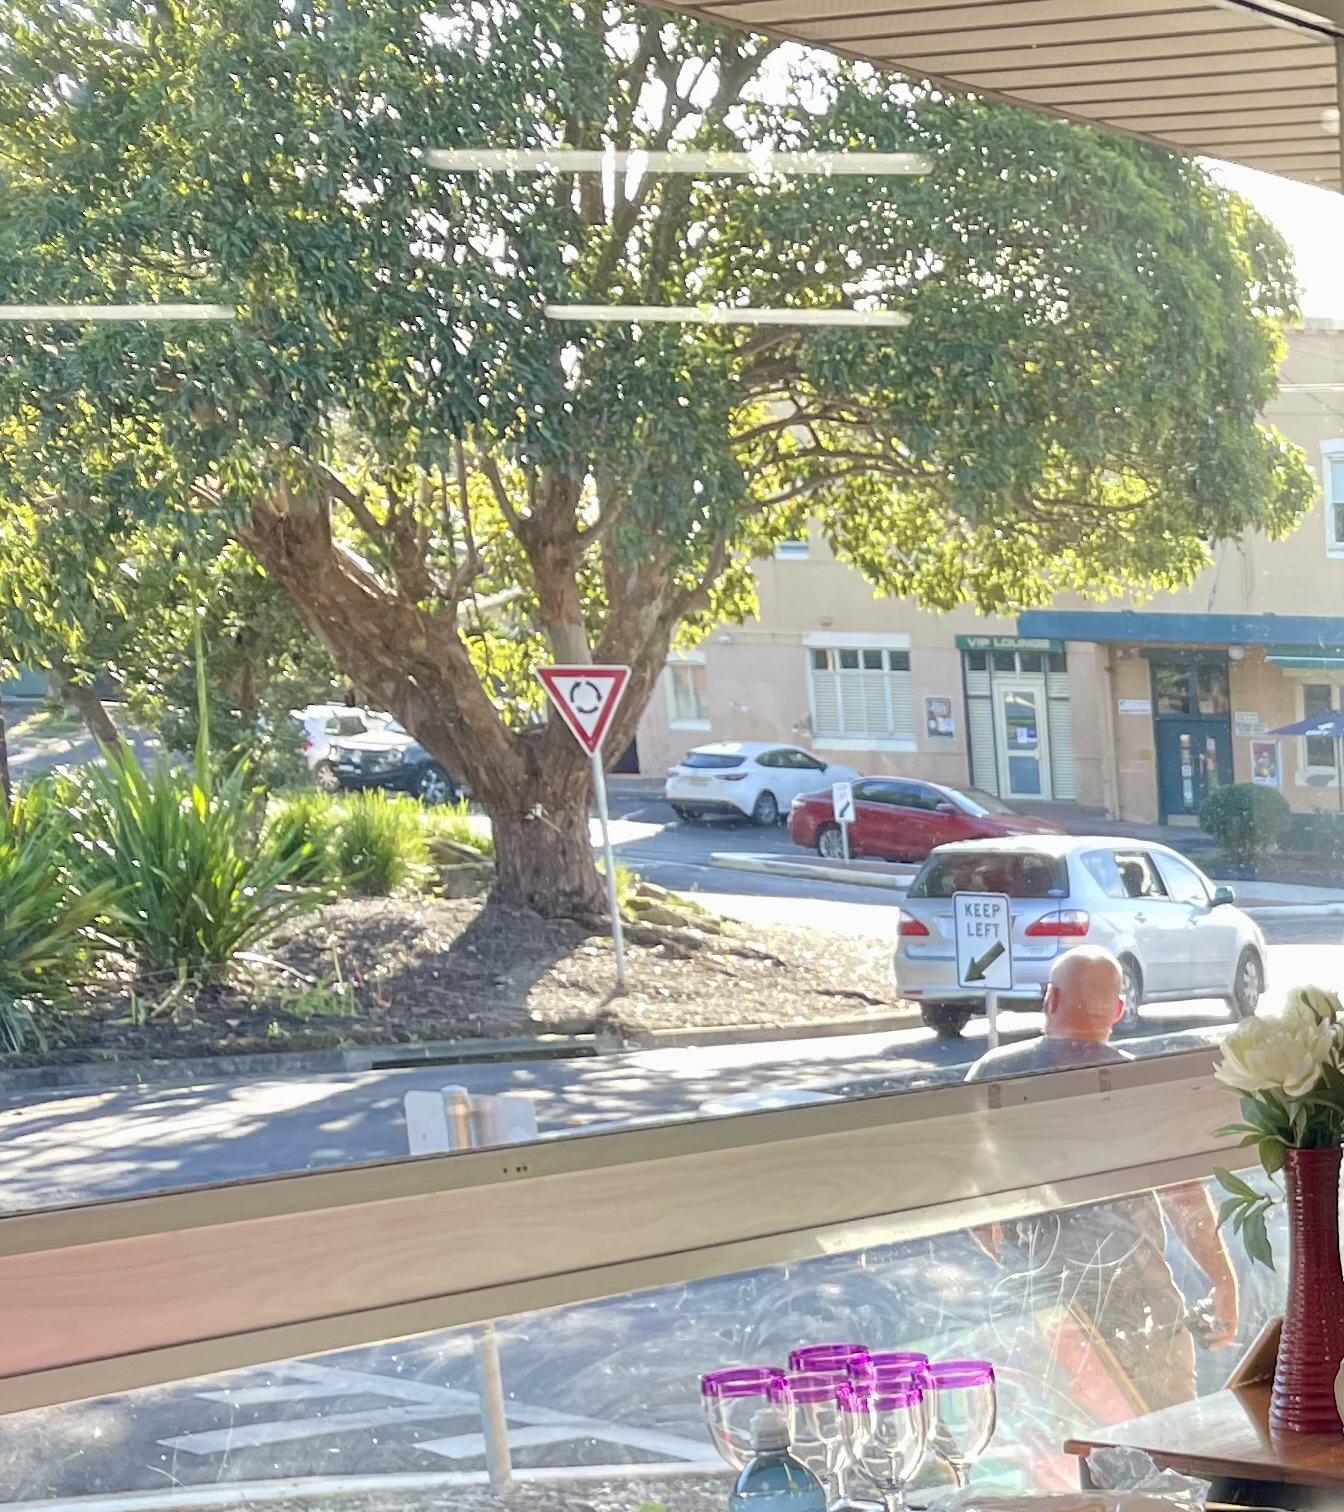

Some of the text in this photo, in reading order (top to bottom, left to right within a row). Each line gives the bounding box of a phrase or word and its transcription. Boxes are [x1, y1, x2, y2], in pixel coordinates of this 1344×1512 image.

[966, 637, 990, 648] VIP
[964, 903, 1001, 918] KEEP
[966, 922, 1000, 938] LEFT
